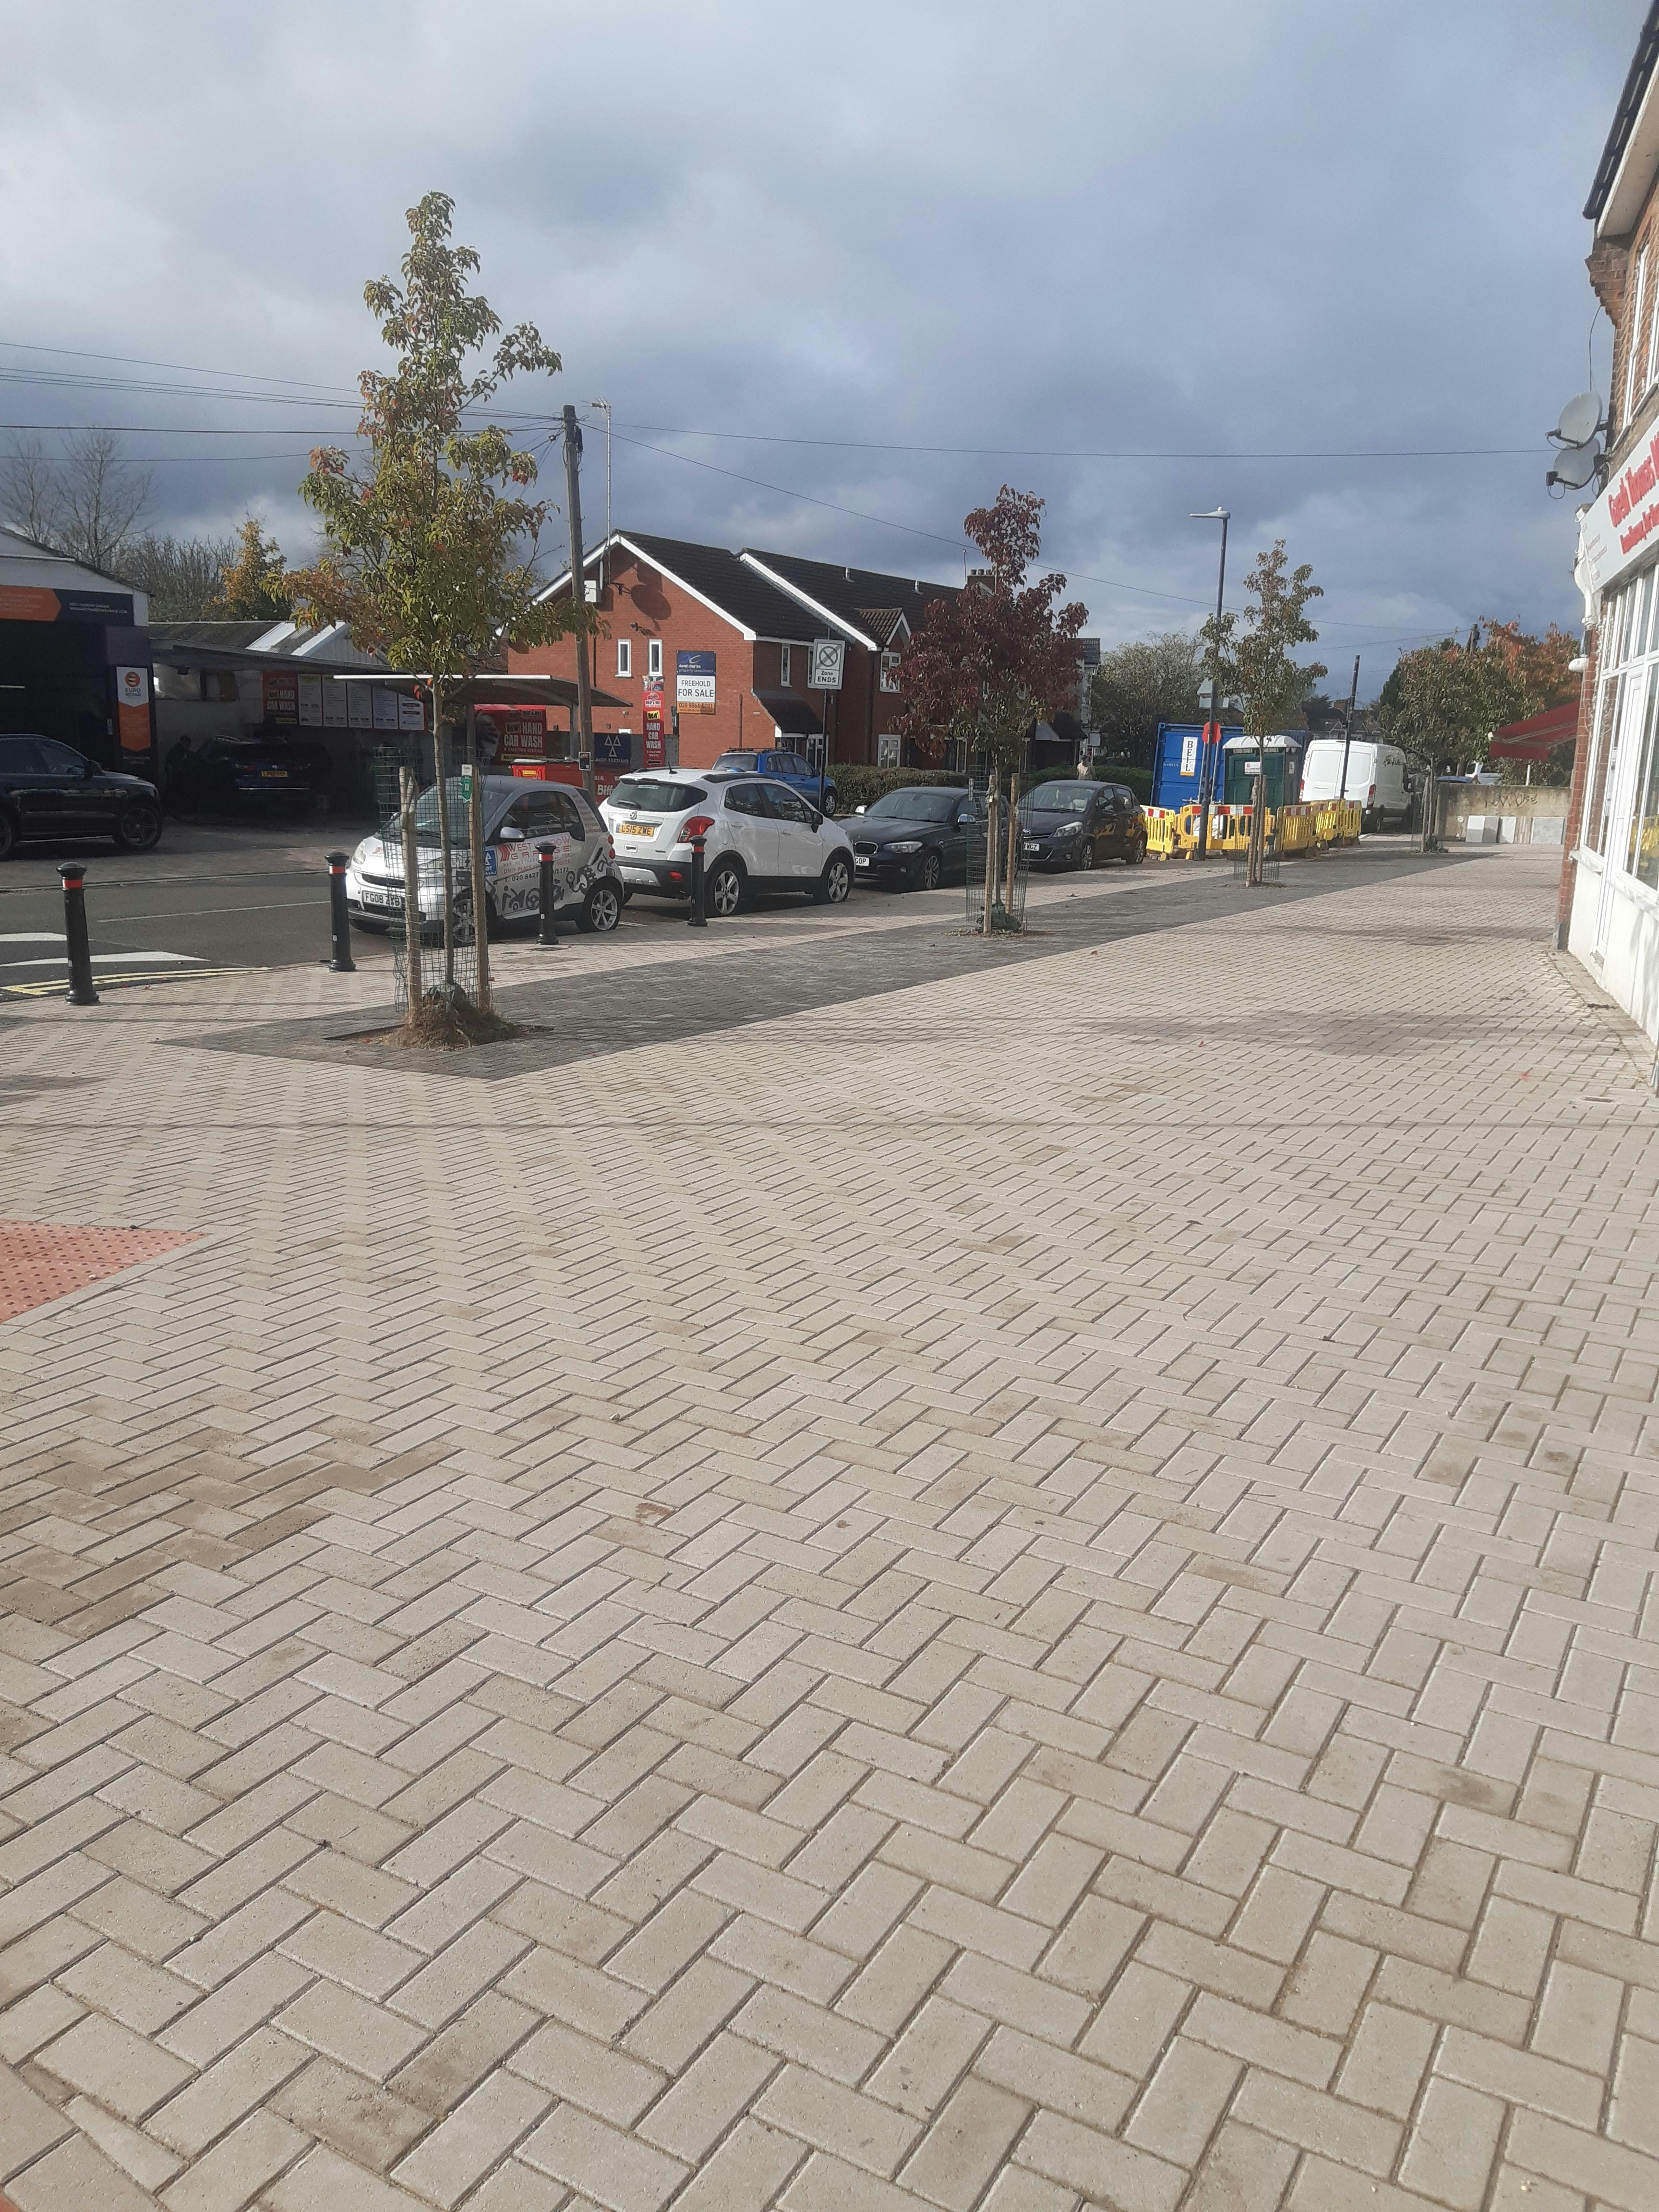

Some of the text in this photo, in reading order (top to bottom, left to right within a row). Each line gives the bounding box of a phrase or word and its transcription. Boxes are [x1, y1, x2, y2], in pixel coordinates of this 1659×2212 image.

[280, 689, 295, 700] HAND
[678, 688, 714, 697] FOR SALE
[522, 721, 542, 734] HAND
[646, 722, 661, 731] HAND
[504, 734, 543, 748] CAR WASH
[648, 732, 659, 740] CAR
[646, 740, 661, 749] WASH
[1185, 740, 1194, 771] BELL
[621, 825, 637, 833] LS15
[507, 842, 532, 852] WEST
[365, 892, 384, 904] FG08
